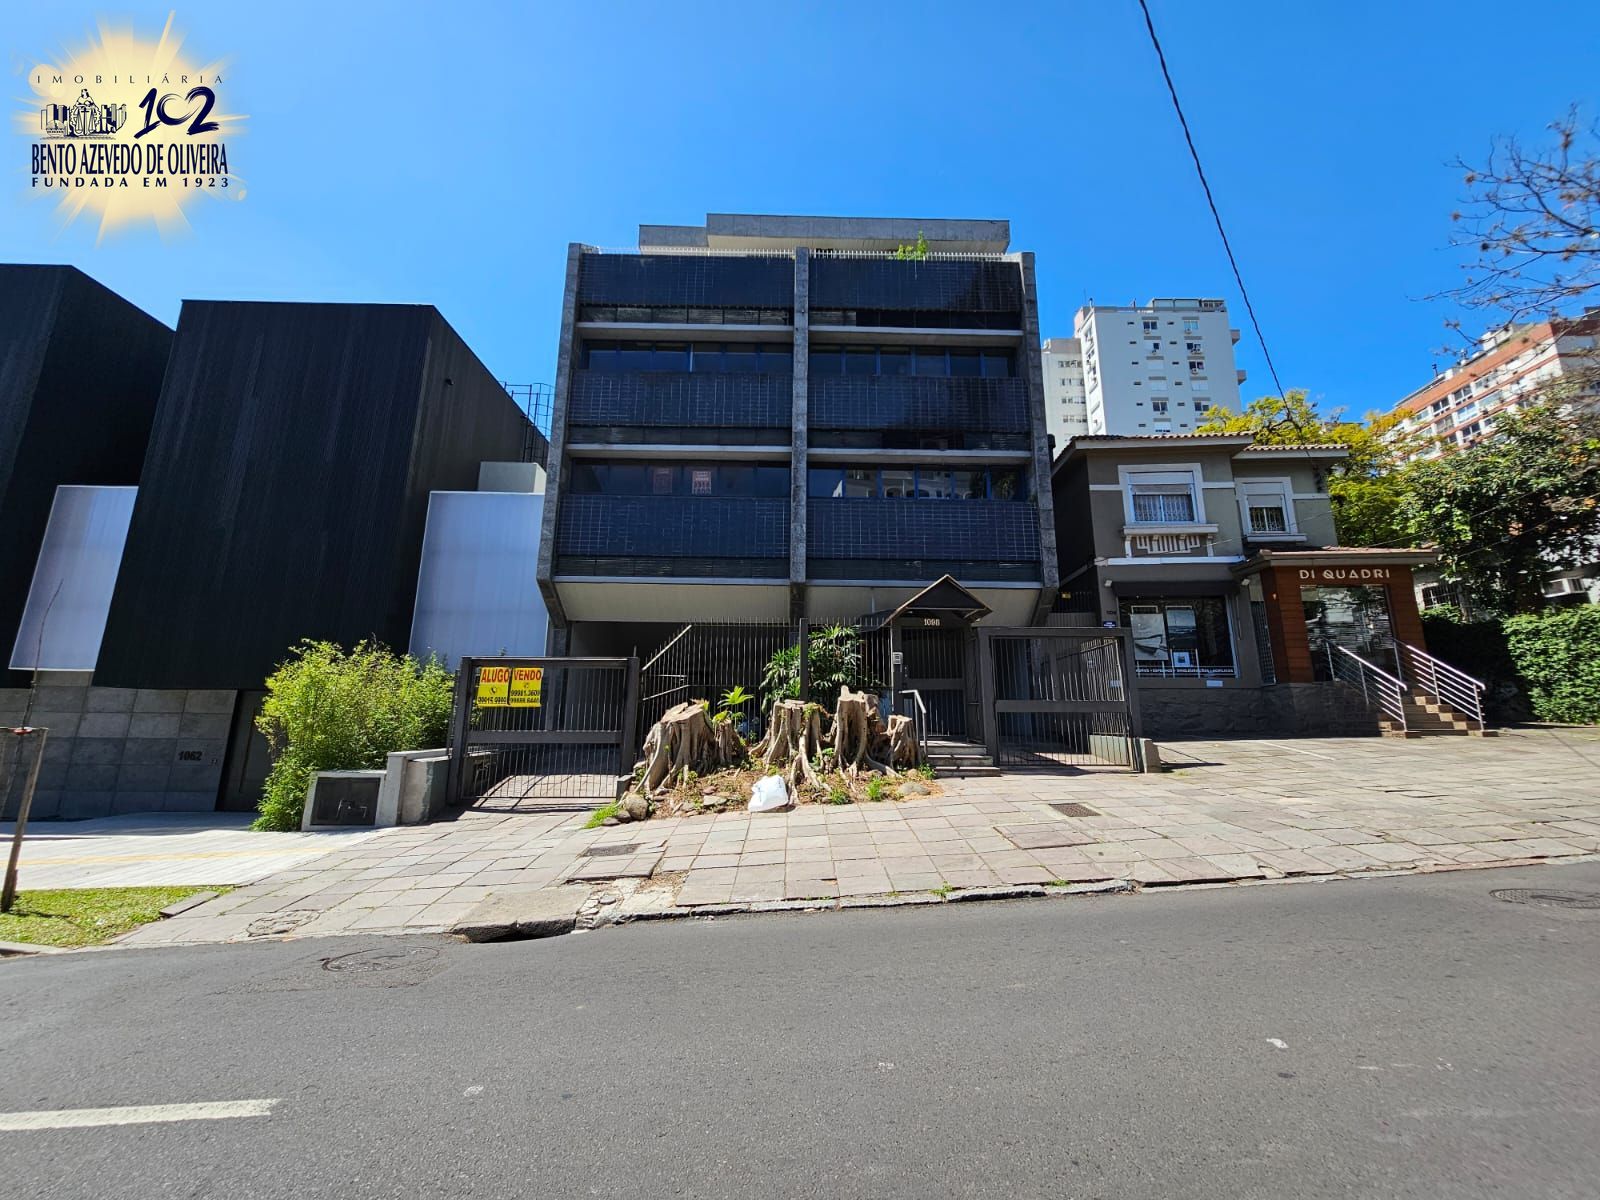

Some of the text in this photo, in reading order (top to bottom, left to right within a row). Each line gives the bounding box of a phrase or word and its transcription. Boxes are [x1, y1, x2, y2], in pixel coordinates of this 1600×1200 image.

[1298, 569, 1390, 579] DI QUADRI
[481, 668, 509, 683] ALUGO
[513, 669, 541, 681] VENDO
[178, 750, 202, 761] 1062
